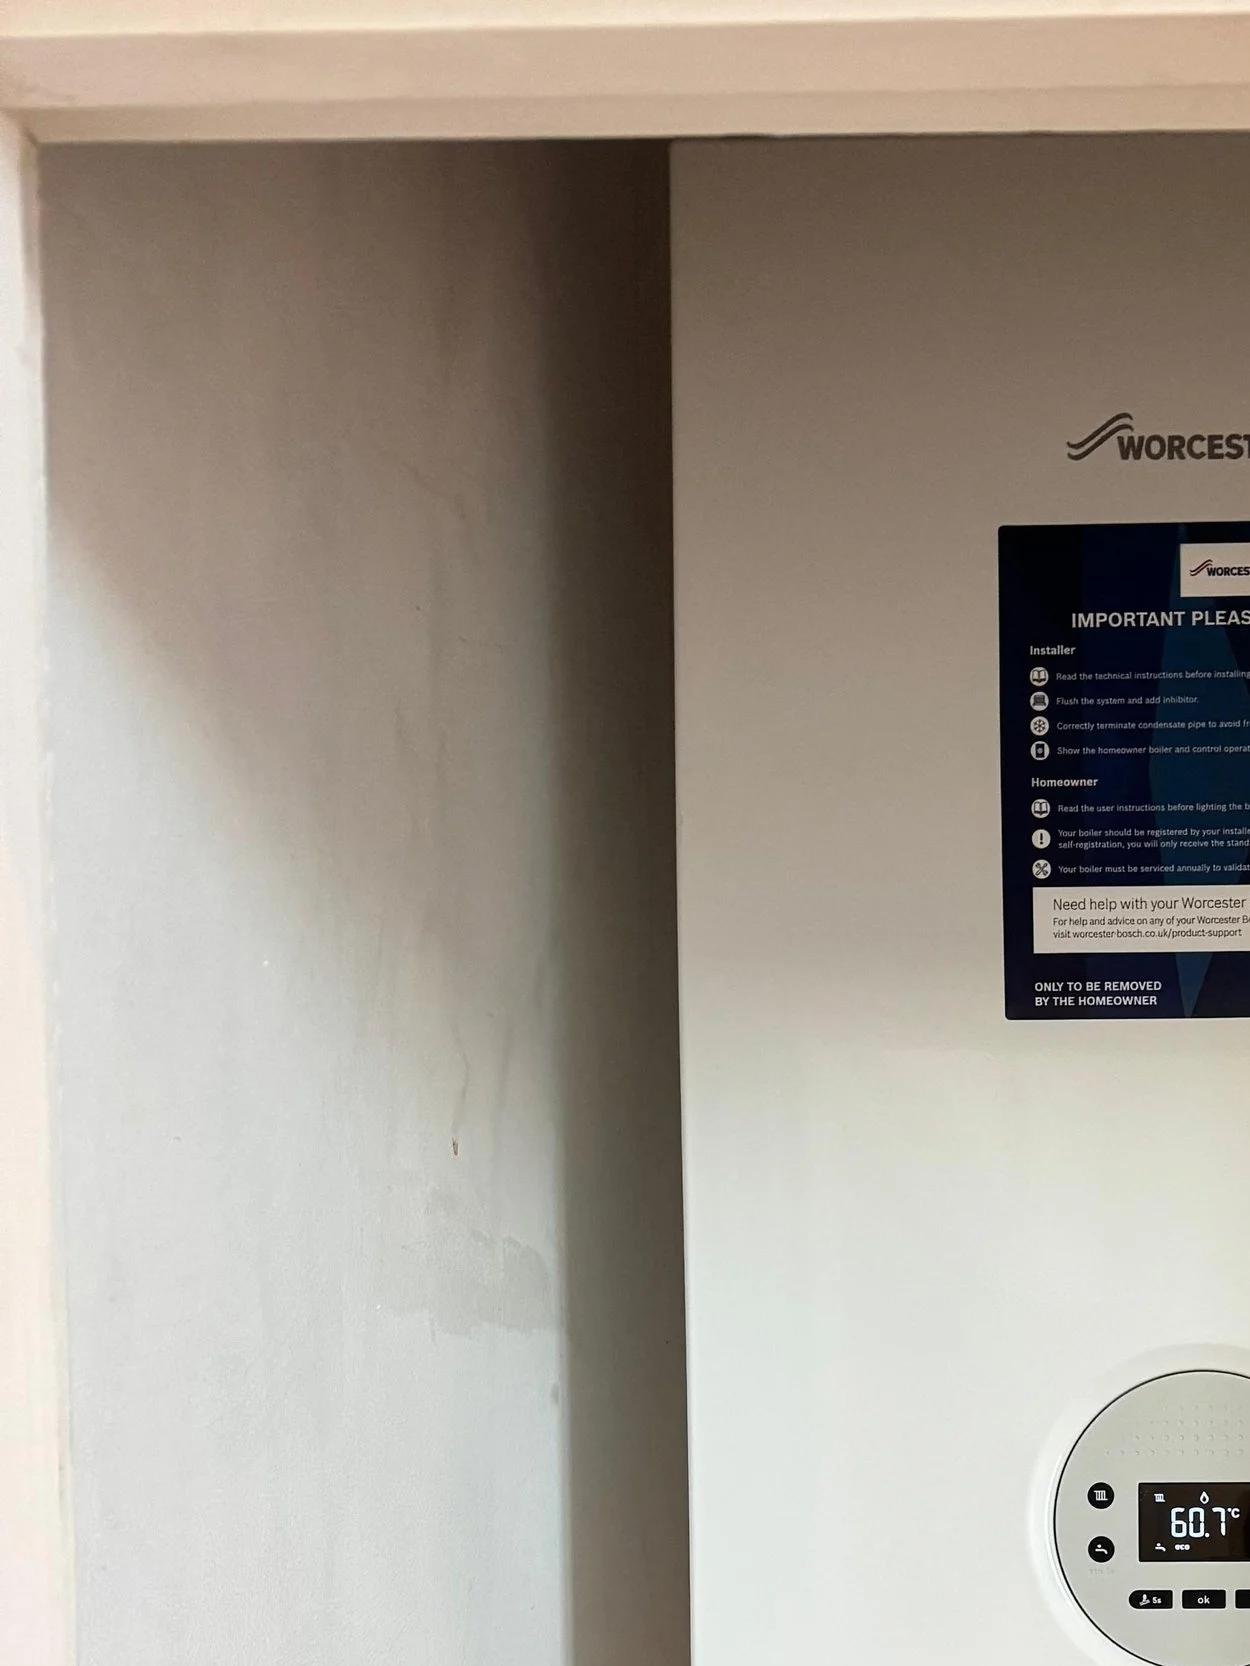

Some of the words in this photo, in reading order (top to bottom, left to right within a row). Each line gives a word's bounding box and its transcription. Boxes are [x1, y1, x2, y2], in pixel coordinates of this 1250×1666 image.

[1071, 611, 1185, 629] IMPORTANT
[1030, 645, 1076, 655] Installer
[1079, 672, 1093, 680] the
[1095, 672, 1132, 680] technical
[1134, 670, 1183, 679] instructions
[1185, 670, 1212, 679] before
[1213, 670, 1250, 679] installing
[1056, 697, 1079, 705] Flush
[1081, 697, 1095, 705] the
[1096, 698, 1125, 707] system
[1127, 697, 1143, 705] and
[1144, 696, 1161, 704] add
[1163, 696, 1199, 704] inhibitor.
[1056, 722, 1095, 731] Correctly
[1096, 722, 1136, 730] terminate
[1138, 721, 1186, 729] condensate
[1187, 720, 1206, 729] pipe
[1208, 720, 1217, 728] to
[1218, 719, 1241, 728] avoid
[1057, 747, 1080, 755] Show
[1082, 747, 1096, 755] the
[1099, 747, 1147, 755] homeowner
[1148, 746, 1172, 754] boiler
[1174, 745, 1190, 754] and
[1191, 745, 1222, 753] control
[1031, 777, 1099, 787] Homeowner
[1057, 804, 1079, 813] Read
[1116, 804, 1165, 812] instructions
[1167, 803, 1194, 811] before
[1196, 803, 1227, 812] lighting
[1058, 829, 1076, 837] Your
[1078, 829, 1102, 837] boiler
[1104, 828, 1132, 837] should
[1134, 828, 1145, 836] be
[1147, 828, 1188, 837] registered
[1190, 828, 1200, 837] by
[1201, 828, 1221, 837] your
[1058, 840, 1125, 850] self-registration,
[1127, 841, 1142, 850] you
[1144, 840, 1158, 848] will
[1160, 840, 1178, 849] only
[1179, 840, 1209, 848] receive
[1058, 865, 1077, 874] Your
[1079, 865, 1104, 873] boiler
[1105, 865, 1125, 873] must
[1127, 865, 1138, 873] be
[1140, 864, 1175, 873] serviced
[1177, 864, 1210, 873] annually
[1053, 898, 1086, 911] Need
[1089, 898, 1117, 911] help
[1120, 897, 1148, 910] with
[1150, 899, 1179, 912] your
[1181, 897, 1246, 909] Worcester
[1053, 917, 1066, 926] For
[1068, 917, 1088, 927] help
[1089, 917, 1105, 925] and
[1107, 916, 1135, 925] advice
[1136, 917, 1148, 925] on
[1149, 917, 1164, 926] any
[1166, 915, 1175, 925] of
[1176, 917, 1195, 926] your
[1197, 915, 1240, 924] Worcester
[1053, 930, 1070, 939] visit
[1034, 982, 1064, 992] ONLY
[1066, 982, 1083, 991] TO
[1086, 981, 1101, 991] BE
[1104, 981, 1162, 991] REMOVED
[1035, 997, 1050, 1006] BY
[1052, 996, 1075, 1006] THE
[1078, 996, 1157, 1006] HOMEOWNER
[1174, 1543, 1190, 1551] eco
[1152, 1596, 1162, 1604] 5s
[1197, 1595, 1210, 1605] ok
